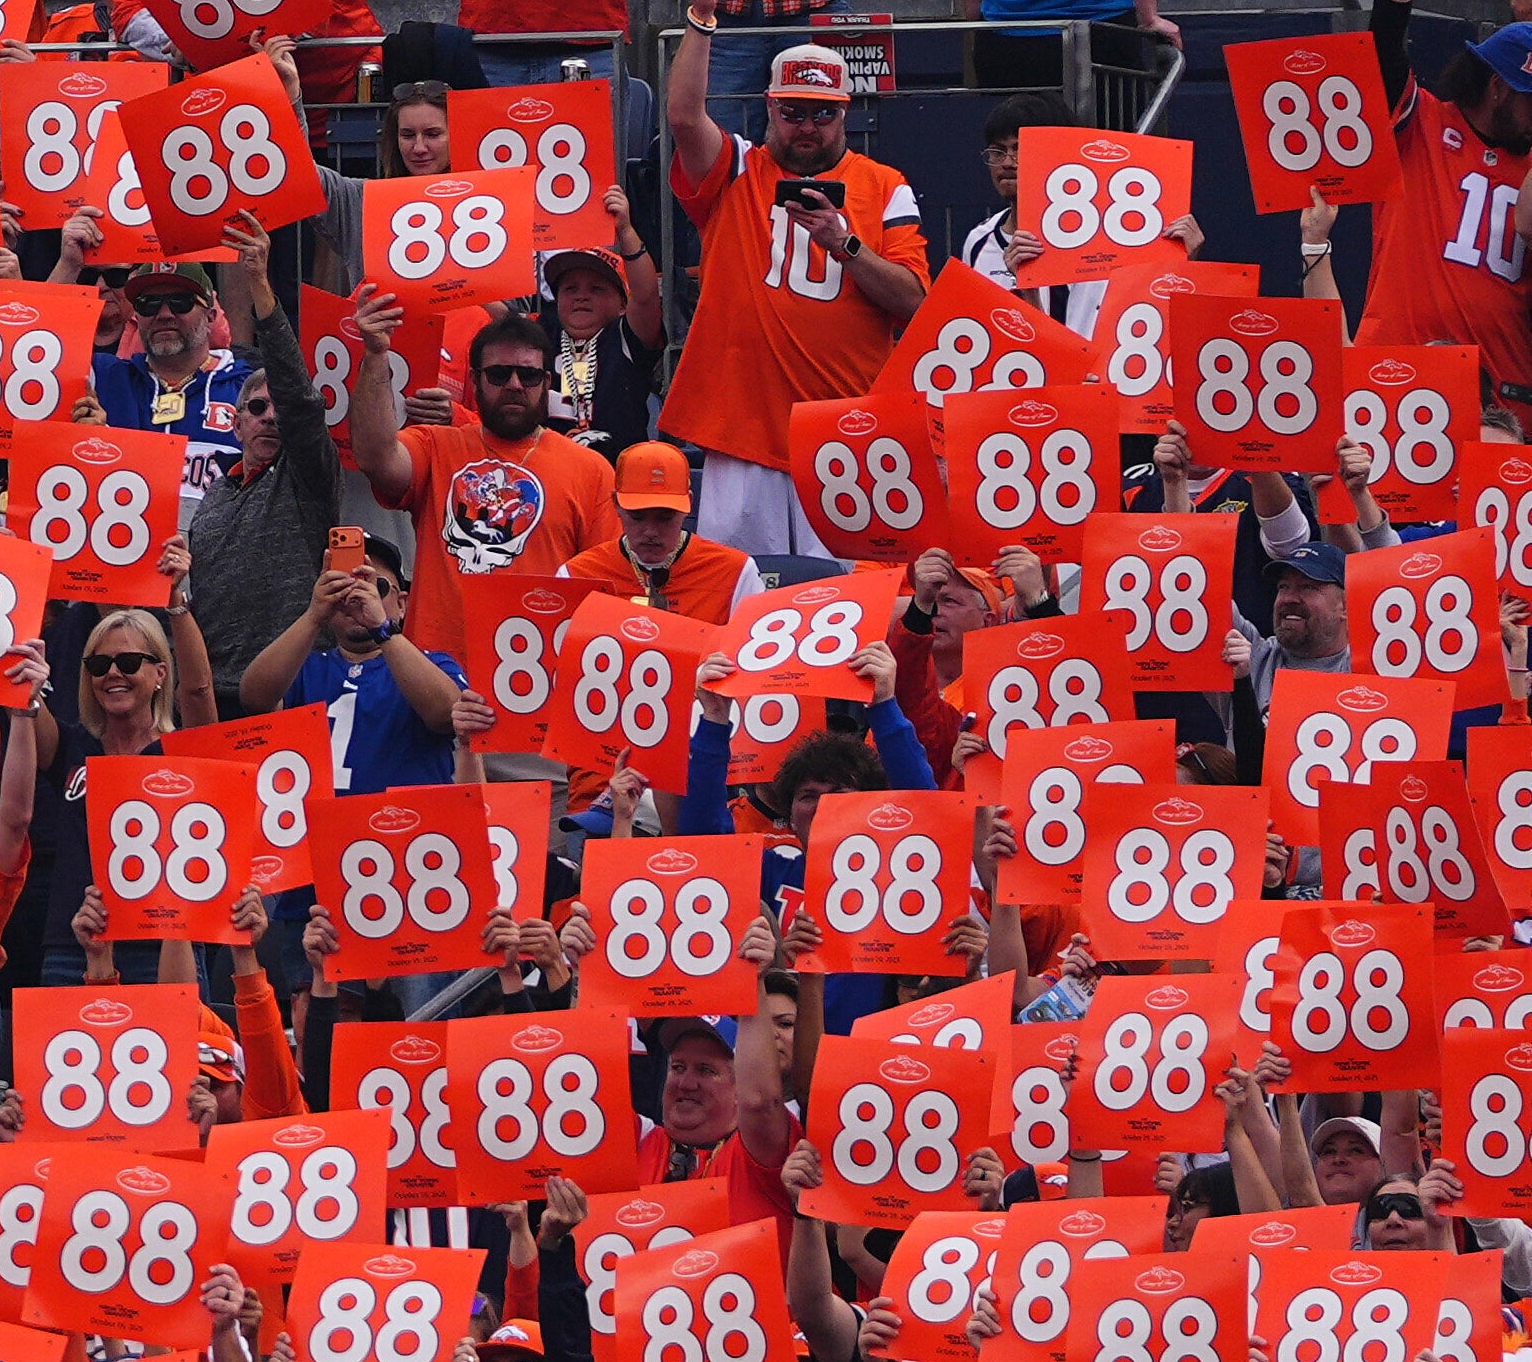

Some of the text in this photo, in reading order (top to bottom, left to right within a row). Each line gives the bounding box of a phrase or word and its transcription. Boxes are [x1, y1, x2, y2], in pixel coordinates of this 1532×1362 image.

[1263, 76, 1372, 171] 88
[388, 195, 507, 279] 88
[764, 204, 845, 302] 10
[1442, 170, 1526, 282] 10
[976, 429, 1096, 529] 88
[606, 877, 732, 978] 88
[1291, 949, 1409, 1052] 88
